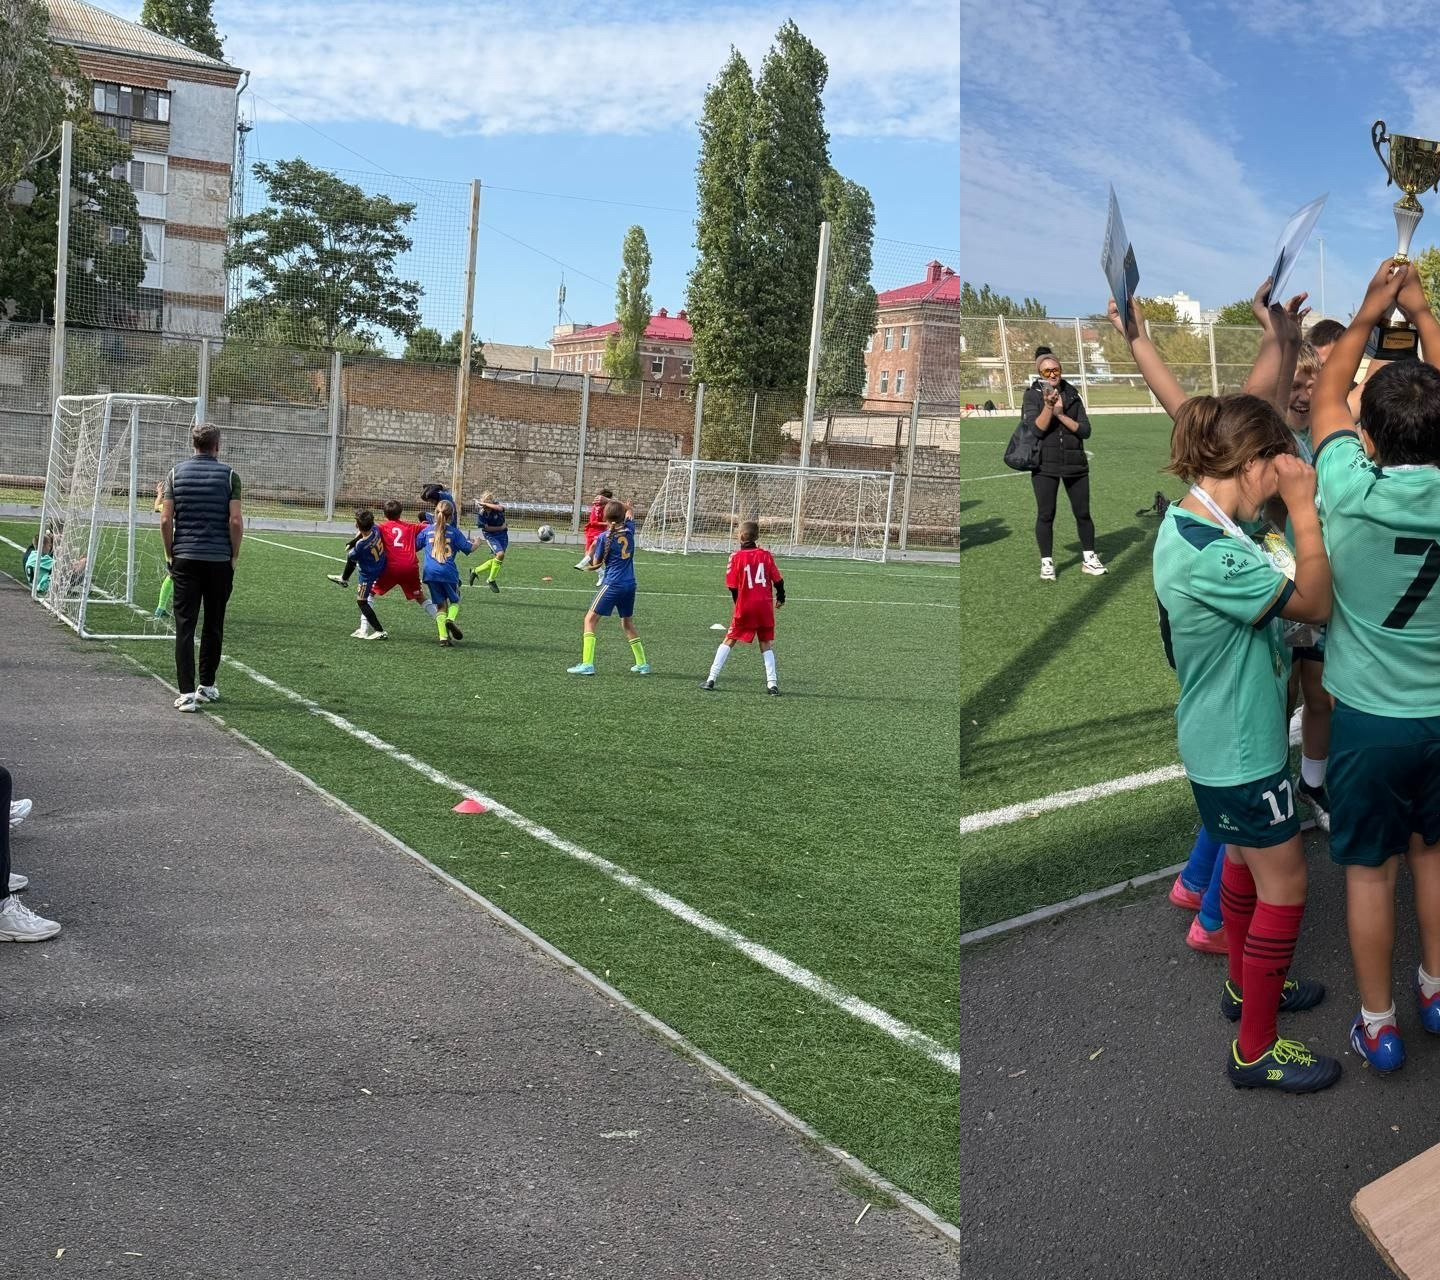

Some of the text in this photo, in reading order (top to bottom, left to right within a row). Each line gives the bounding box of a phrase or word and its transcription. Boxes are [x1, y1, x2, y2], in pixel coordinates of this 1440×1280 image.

[391, 527, 404, 547] 2
[617, 536, 631, 560] 2
[743, 562, 767, 589] 14
[1223, 559, 1249, 580] KELME
[1262, 779, 1294, 827] 17
